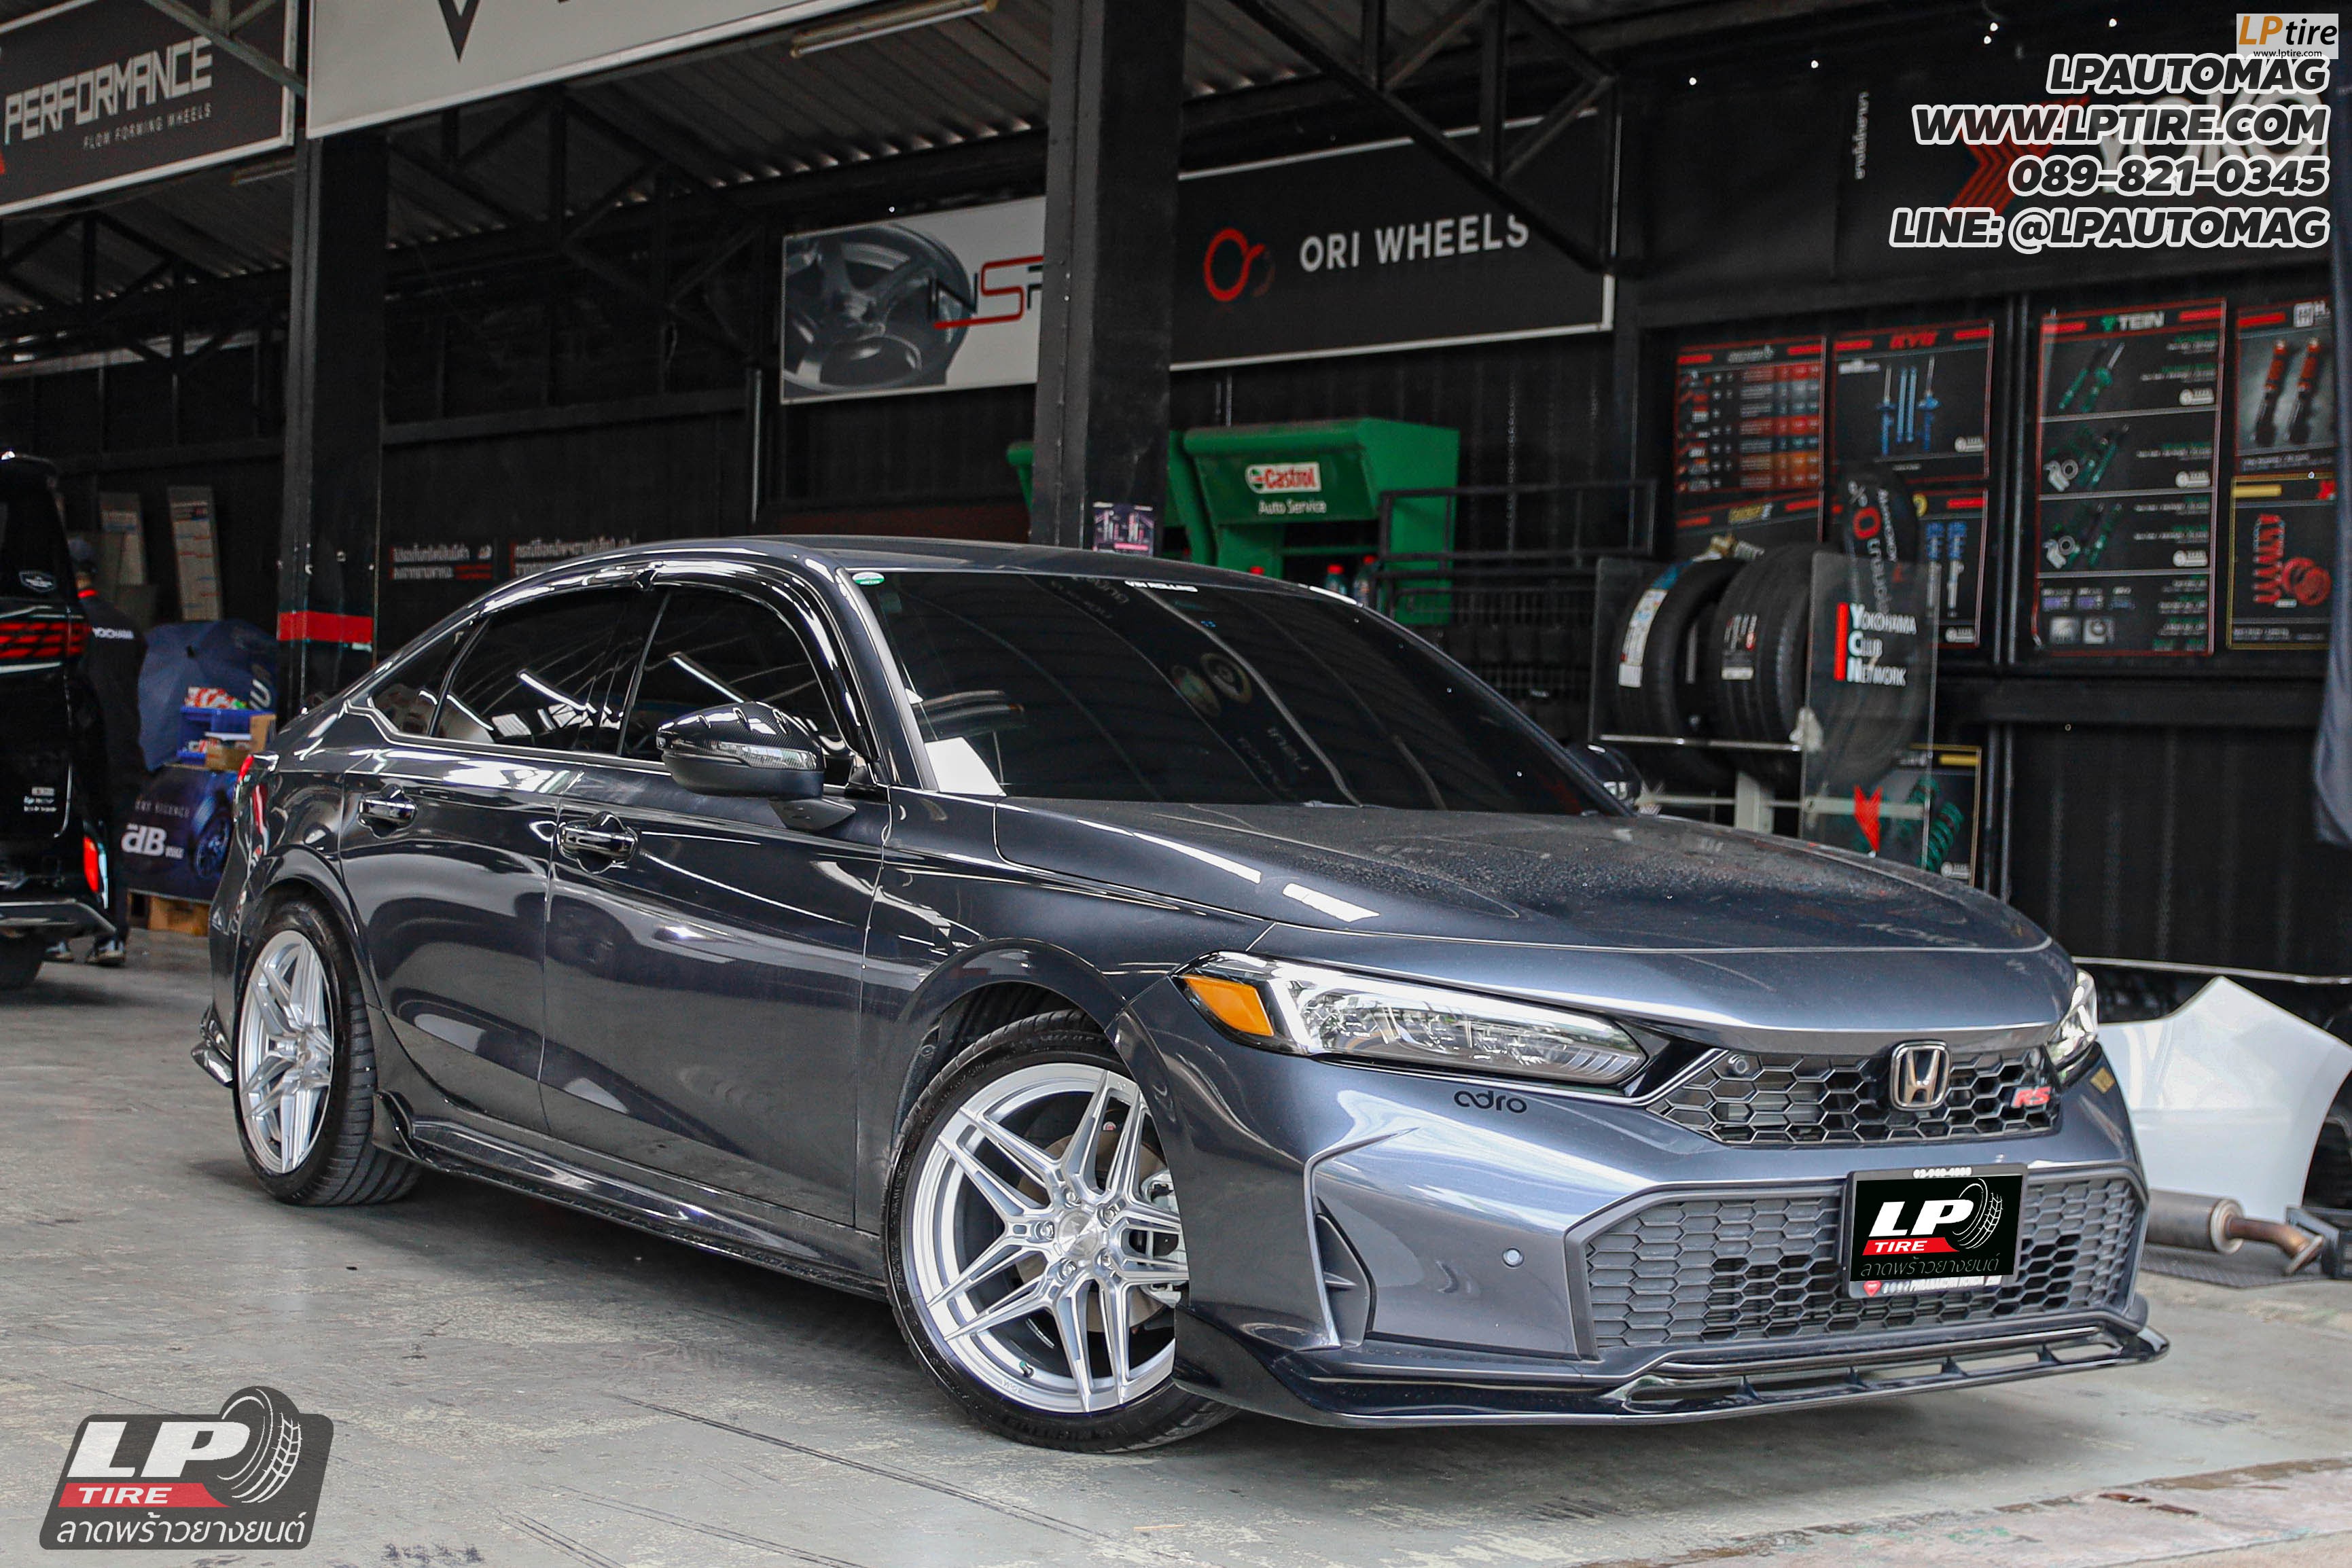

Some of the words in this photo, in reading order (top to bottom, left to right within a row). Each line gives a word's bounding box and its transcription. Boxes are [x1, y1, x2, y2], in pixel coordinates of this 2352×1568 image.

[4, 35, 213, 145] PERFORMANCE
[113, 115, 164, 141] FORMING
[166, 102, 211, 128] WHEELS
[1299, 231, 1359, 272] ORI
[1374, 212, 1529, 264] WHEELS
[927, 255, 1044, 330] INS
[2118, 310, 2165, 332] TEIN
[1264, 467, 1315, 489] Castrol
[1258, 499, 1286, 516] Auto
[1286, 497, 1327, 514] Service
[1849, 602, 1917, 635] YOKOHAMA
[1847, 630, 1883, 658] CLUB
[1847, 656, 1907, 687] NETWORK
[121, 825, 167, 857] dB
[2011, 1086, 2052, 1109] RS
